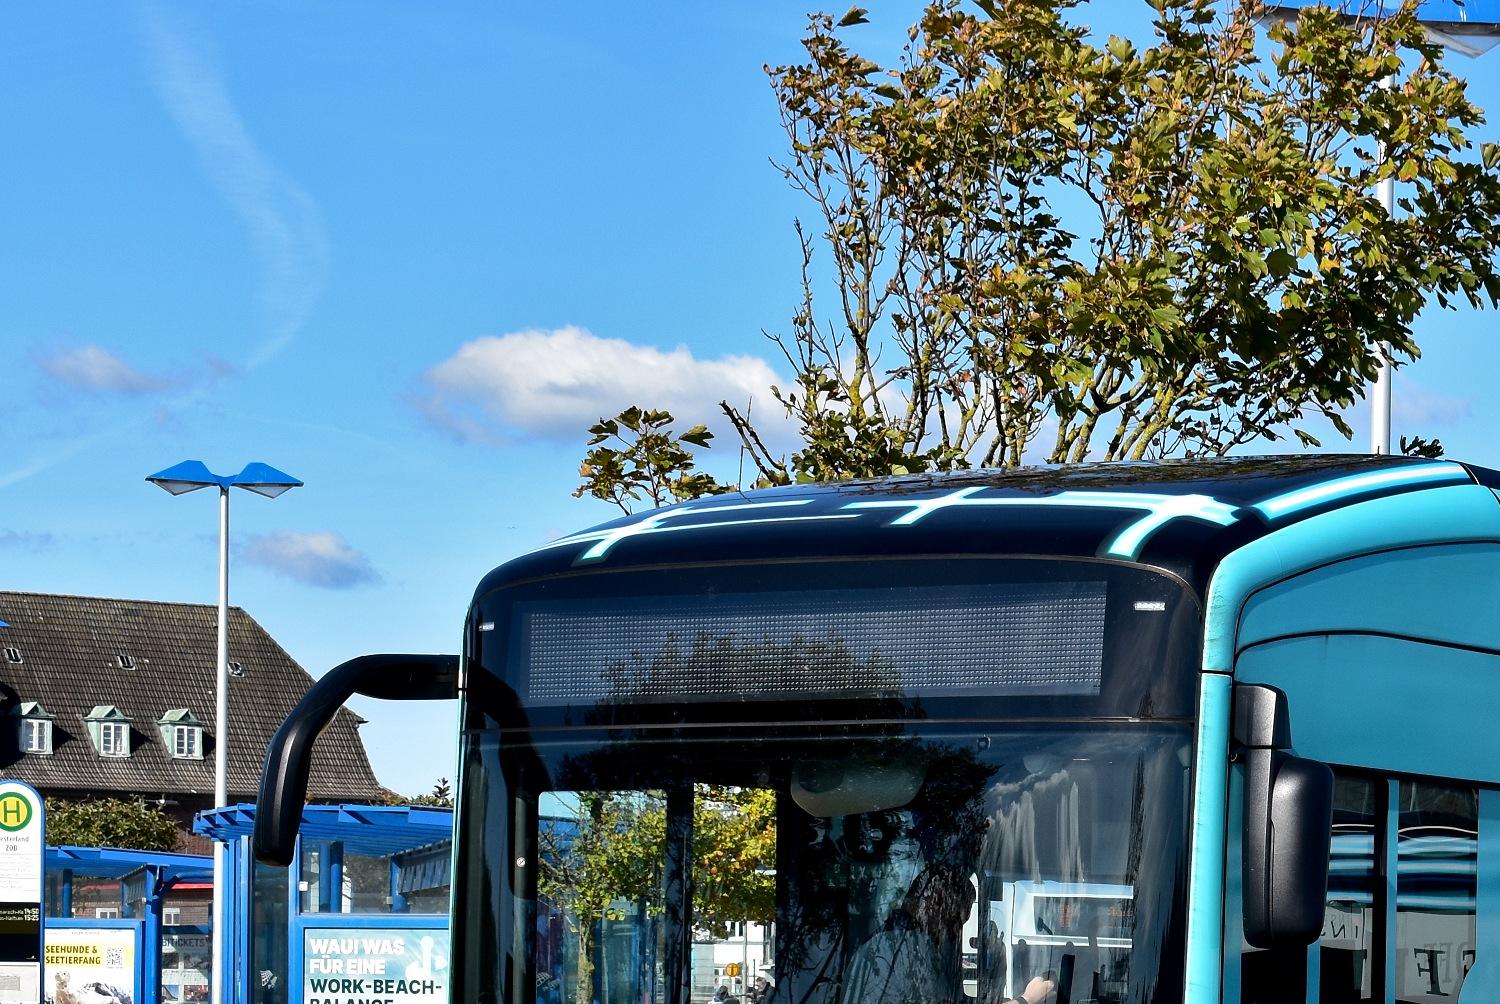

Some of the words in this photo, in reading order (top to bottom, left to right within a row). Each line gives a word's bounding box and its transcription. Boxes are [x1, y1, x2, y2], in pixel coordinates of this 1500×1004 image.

[4, 801, 20, 822] H
[45, 945, 90, 954] SEEHUNDE
[92, 945, 98, 954] &
[161, 936, 205, 949] BITICKETS
[361, 939, 404, 955] WAS
[45, 956, 101, 965] SEETIERFANG
[309, 954, 343, 974] FÜR
[346, 958, 386, 975] EINE
[310, 978, 442, 995] WORK-BEACH-
